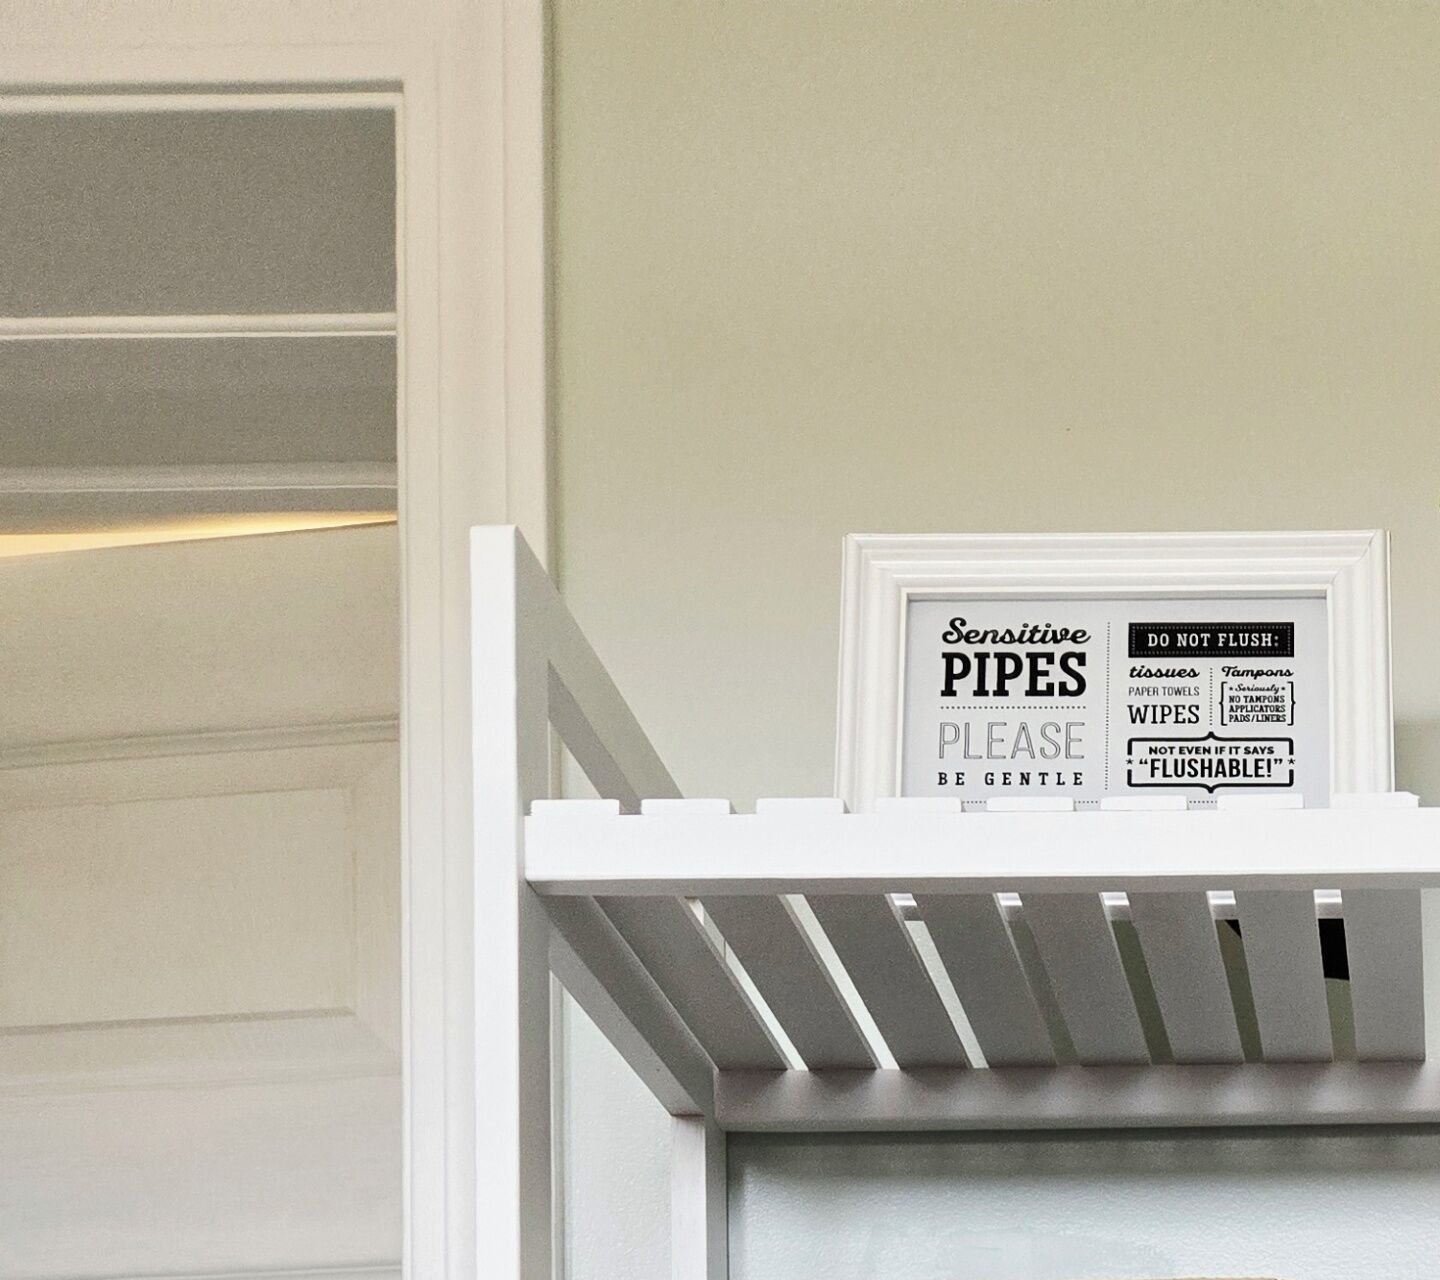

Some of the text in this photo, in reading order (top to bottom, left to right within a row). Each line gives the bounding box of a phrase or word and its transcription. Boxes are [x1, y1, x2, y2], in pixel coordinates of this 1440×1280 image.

[941, 617, 1092, 644] Sensitive
[1147, 633, 1279, 647] DO NOT FLUSH:
[940, 651, 1087, 697] PIPES
[1129, 665, 1200, 678] tissues
[1221, 666, 1294, 680] Tampons
[1128, 686, 1200, 696] PAPER TOWELS
[1234, 683, 1280, 695] Seriously
[1228, 695, 1286, 703] NO TAMPONS
[1127, 704, 1200, 724] WIPES
[1228, 704, 1287, 713] APPLICATORS
[1228, 714, 1287, 722] PADS/LINERS
[938, 722, 1085, 759] PLEASE
[1148, 746, 1275, 755] NOT EVEN IF IT SAYS
[1139, 758, 1283, 778] “FLUSHABLE!”
[938, 772, 1083, 786] BE GENTLE
